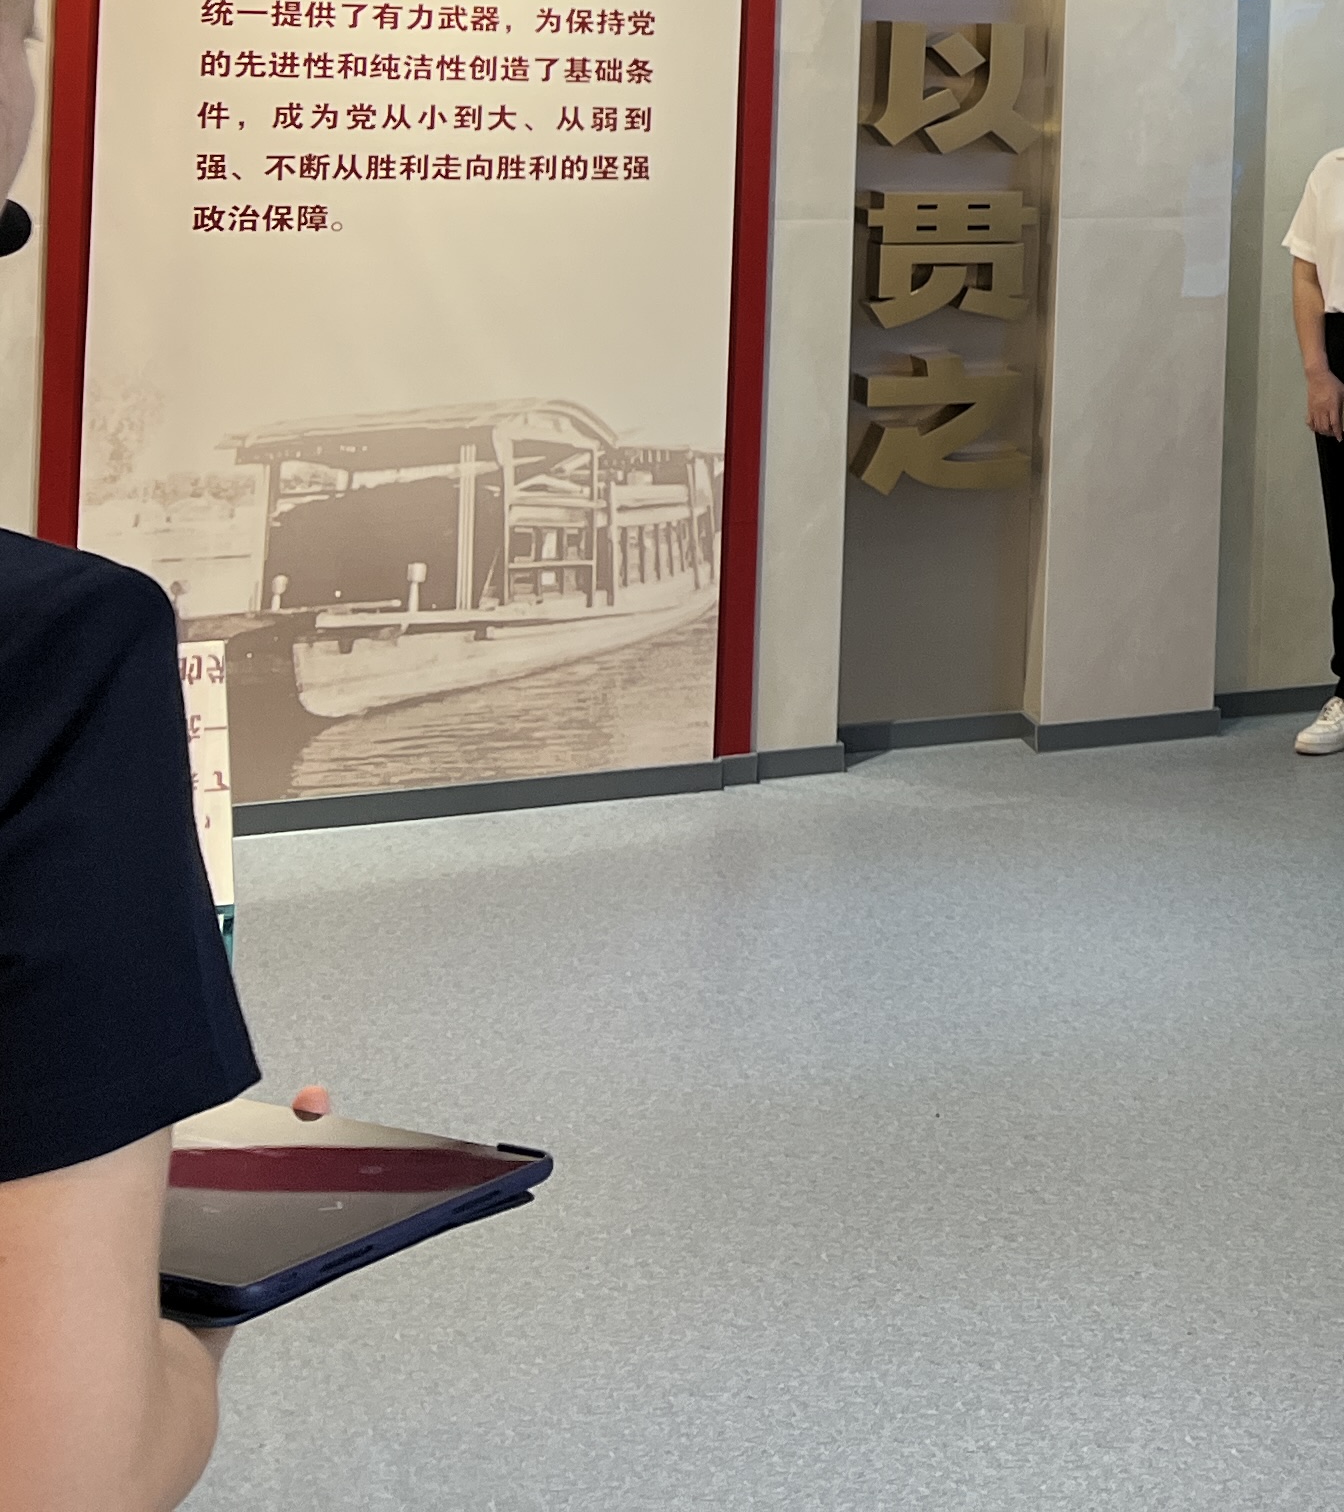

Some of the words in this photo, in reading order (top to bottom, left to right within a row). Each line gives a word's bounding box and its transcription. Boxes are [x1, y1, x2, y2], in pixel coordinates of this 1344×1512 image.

[200, 50, 653, 84] 的先进性和纯洁性创造了基础条
[197, 101, 652, 132] 件，成为党从小到大、从弱到
[196, 153, 650, 182] 强、不断从胜利走向胜利的坚强
[192, 204, 342, 232] 政治保障。
